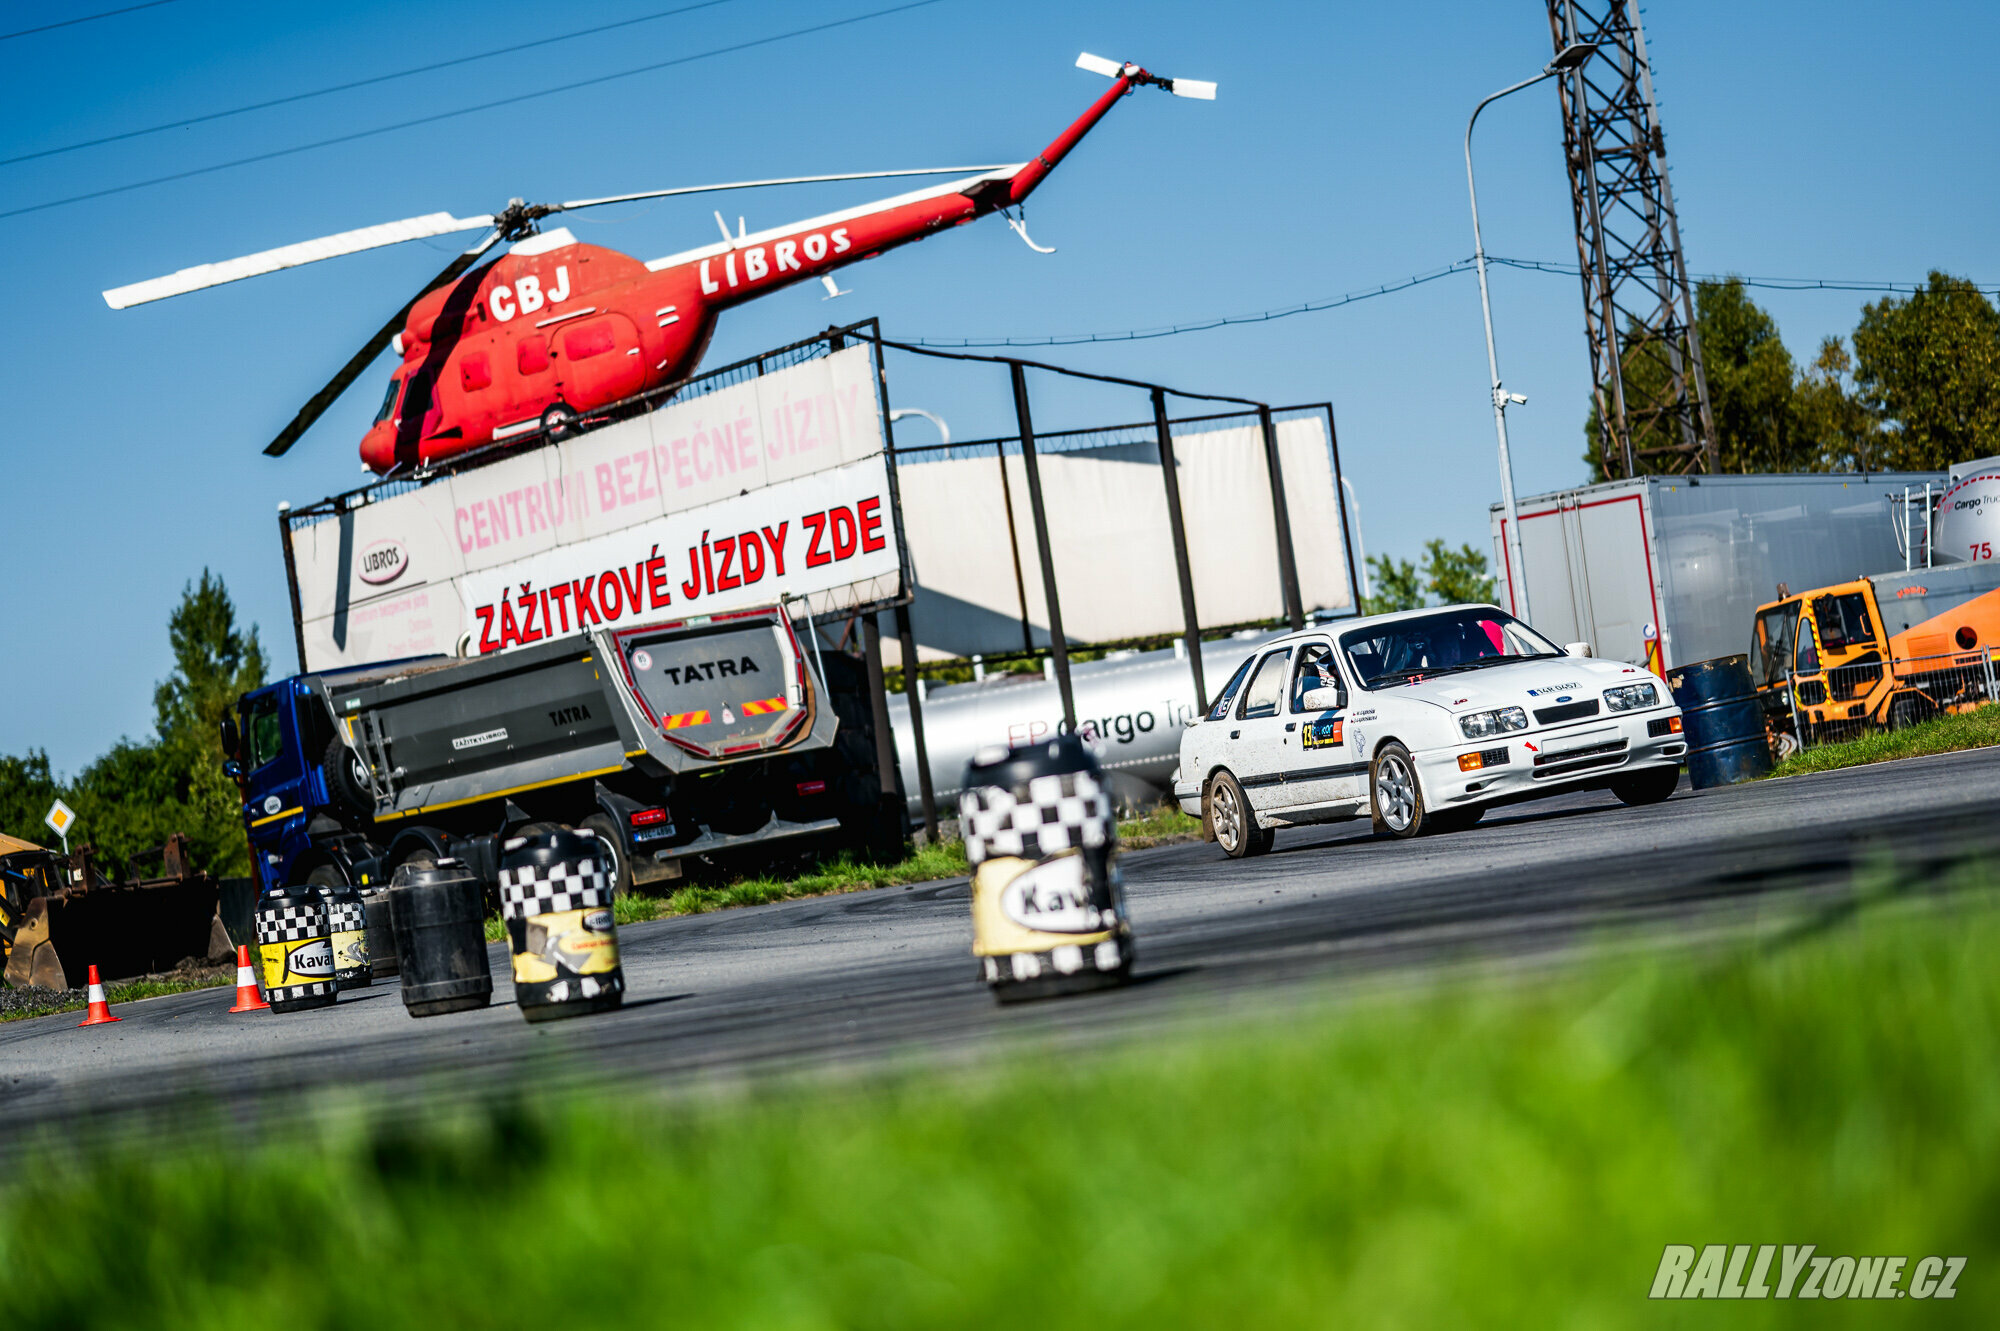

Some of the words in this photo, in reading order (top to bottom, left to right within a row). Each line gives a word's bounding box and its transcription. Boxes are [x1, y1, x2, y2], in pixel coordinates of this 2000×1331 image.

[699, 227, 852, 296] LIBROS
[489, 265, 570, 322] CBJ
[455, 471, 590, 555] CENTRUM
[595, 405, 759, 513] BEZPEČNÉ
[767, 383, 859, 461] JÍZDY
[1954, 498, 1981, 511] Cargo
[363, 547, 400, 574] LIBROS
[1969, 541, 1993, 561] 75
[475, 544, 672, 654] ZÁŽITKOVÉ
[681, 520, 790, 601] JÍZDY
[802, 495, 887, 570] ZDE
[664, 656, 760, 686] TATRA
[549, 704, 592, 728] TATRA
